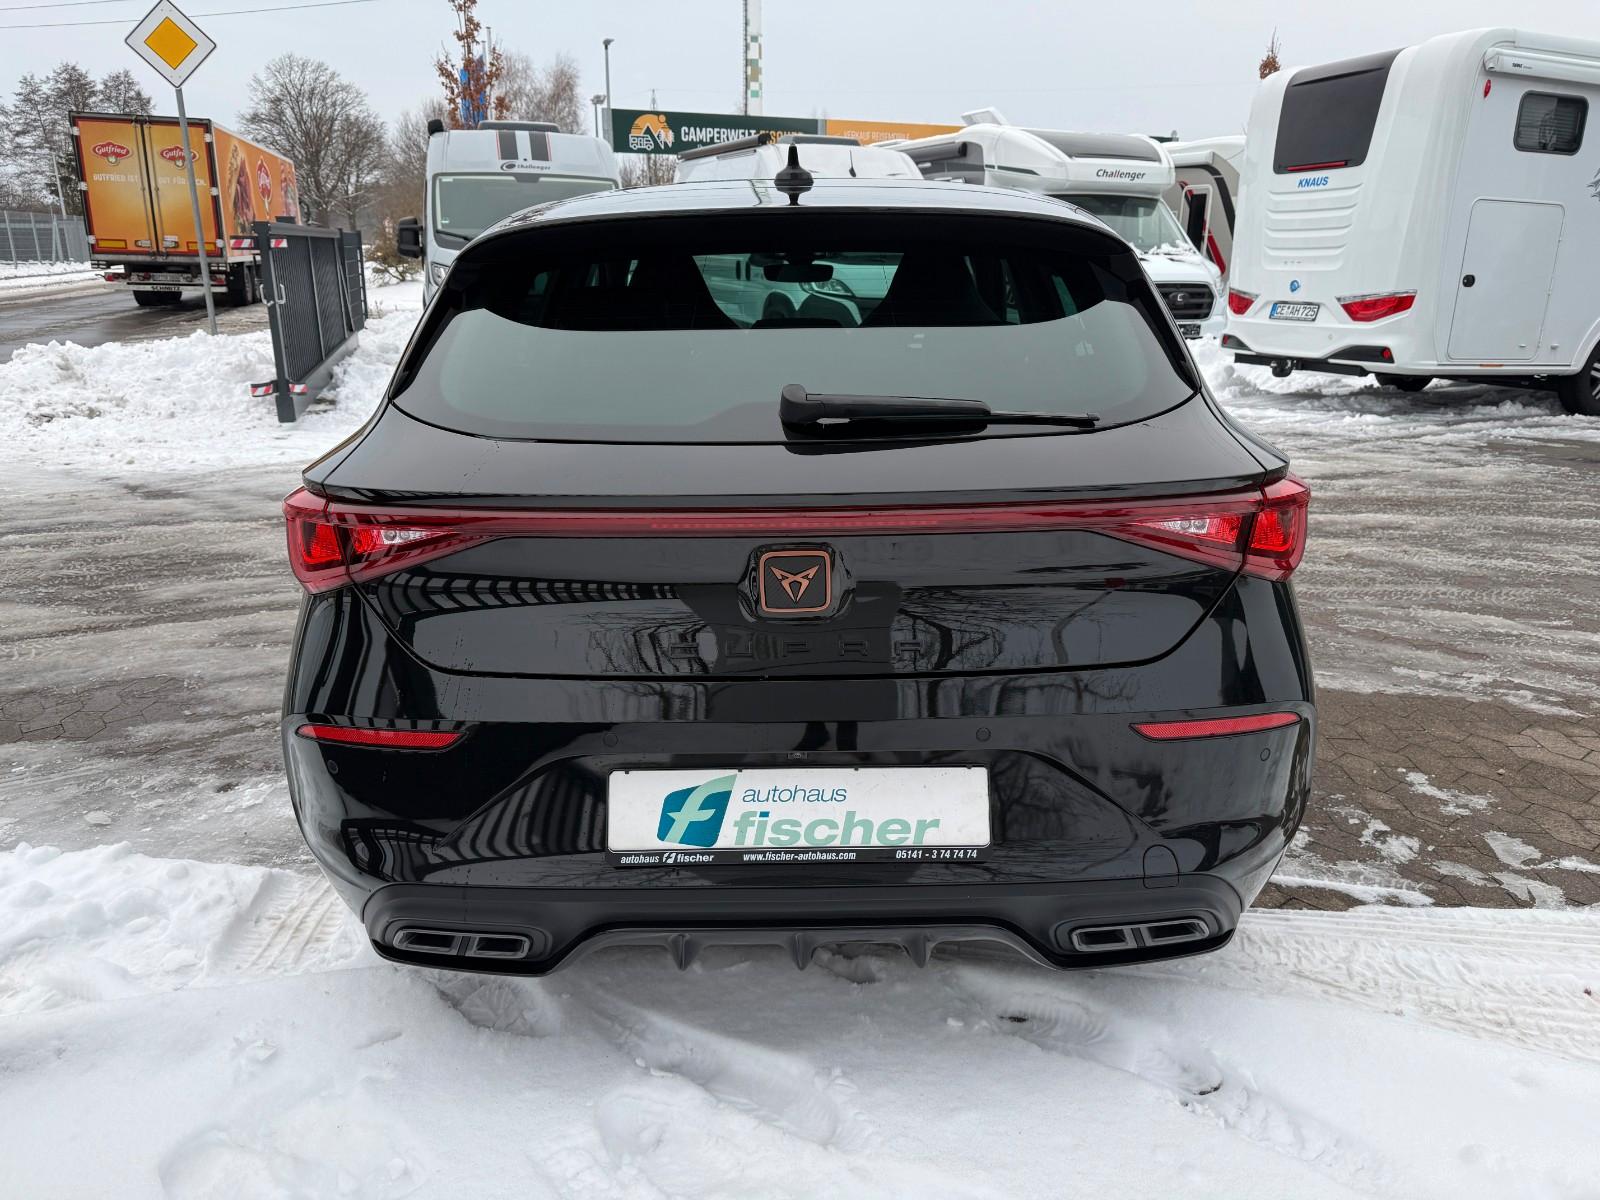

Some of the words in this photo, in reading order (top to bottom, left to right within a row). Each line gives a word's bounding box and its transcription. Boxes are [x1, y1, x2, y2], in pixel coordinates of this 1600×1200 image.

[95, 144, 127, 155] Gutfried
[1096, 168, 1146, 181] Challenger
[1297, 176, 1329, 188] KNAUS
[1301, 306, 1317, 317] 725
[742, 785, 848, 803] autohaus
[733, 810, 941, 847] fischer
[620, 854, 660, 864] autohaus
[677, 853, 715, 863] fischer
[743, 851, 857, 862] www.fischer-autohaus.com
[895, 849, 923, 859] 05141
[931, 849, 938, 859] 3
[940, 849, 951, 859] 74
[953, 849, 964, 859] 74
[966, 849, 978, 859] 74
